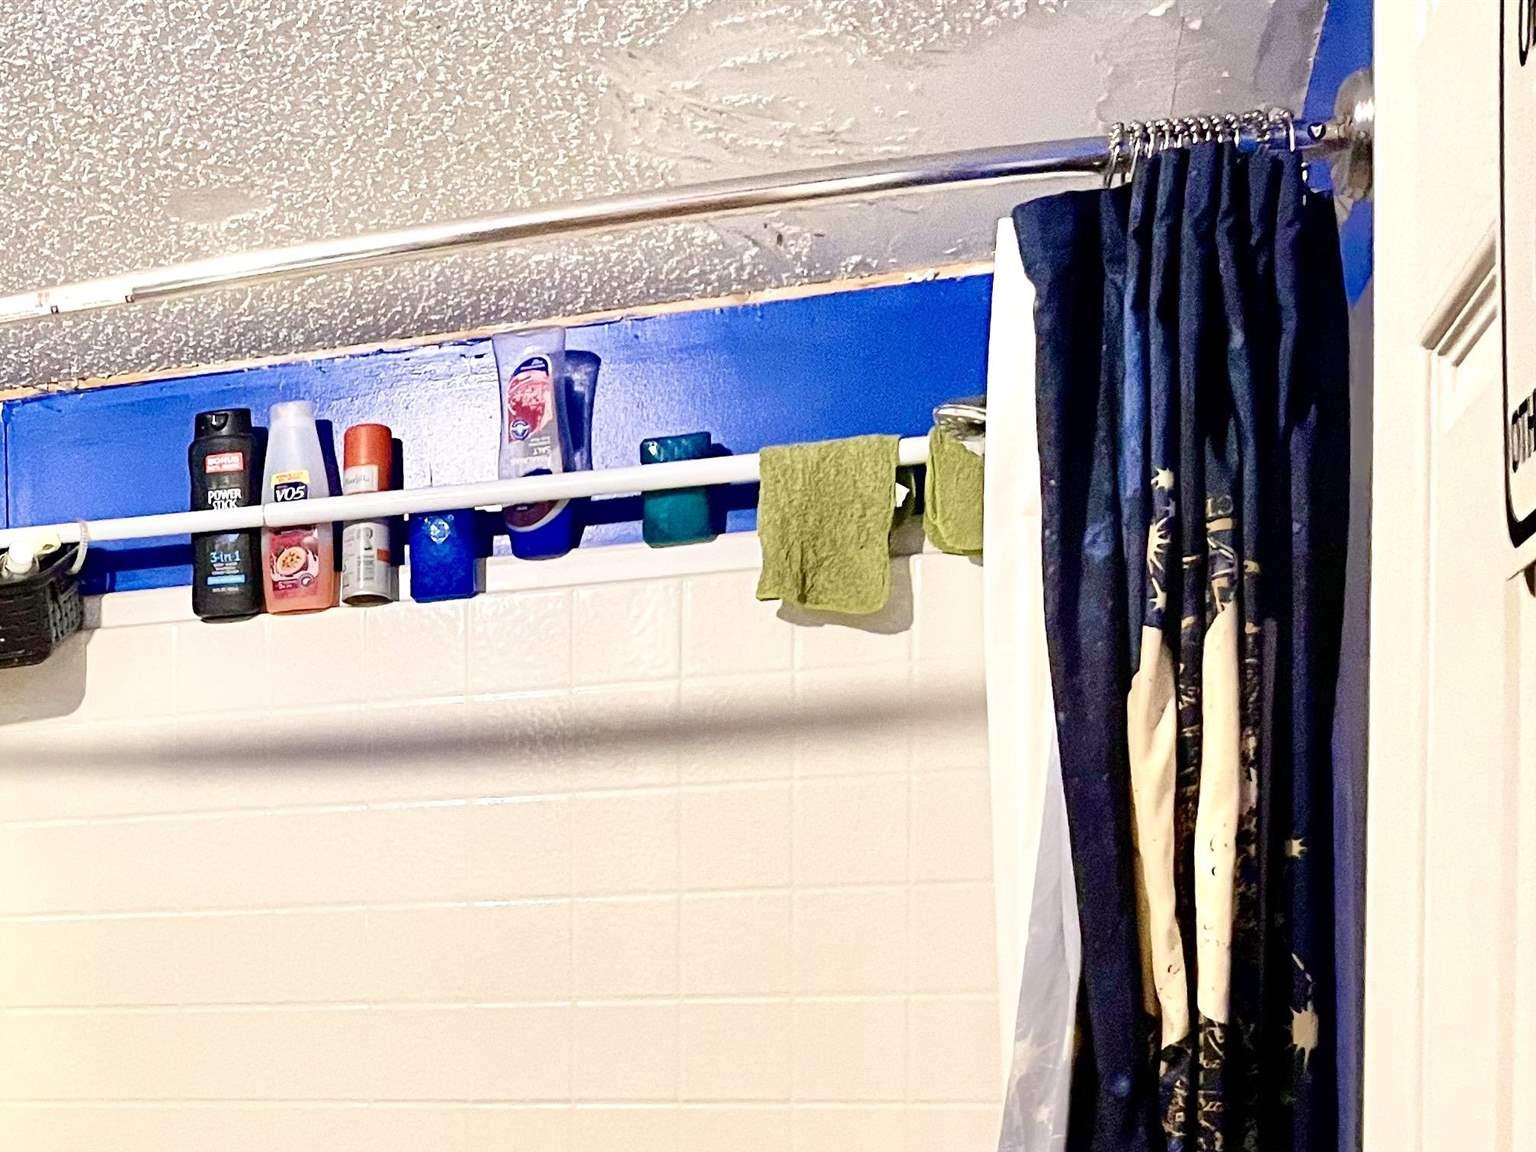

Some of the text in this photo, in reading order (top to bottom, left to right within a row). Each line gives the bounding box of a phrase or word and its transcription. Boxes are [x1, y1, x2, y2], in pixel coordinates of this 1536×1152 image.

[208, 488, 242, 504] POWER
[276, 486, 306, 500] VO5
[210, 551, 241, 563] 3-in-1
